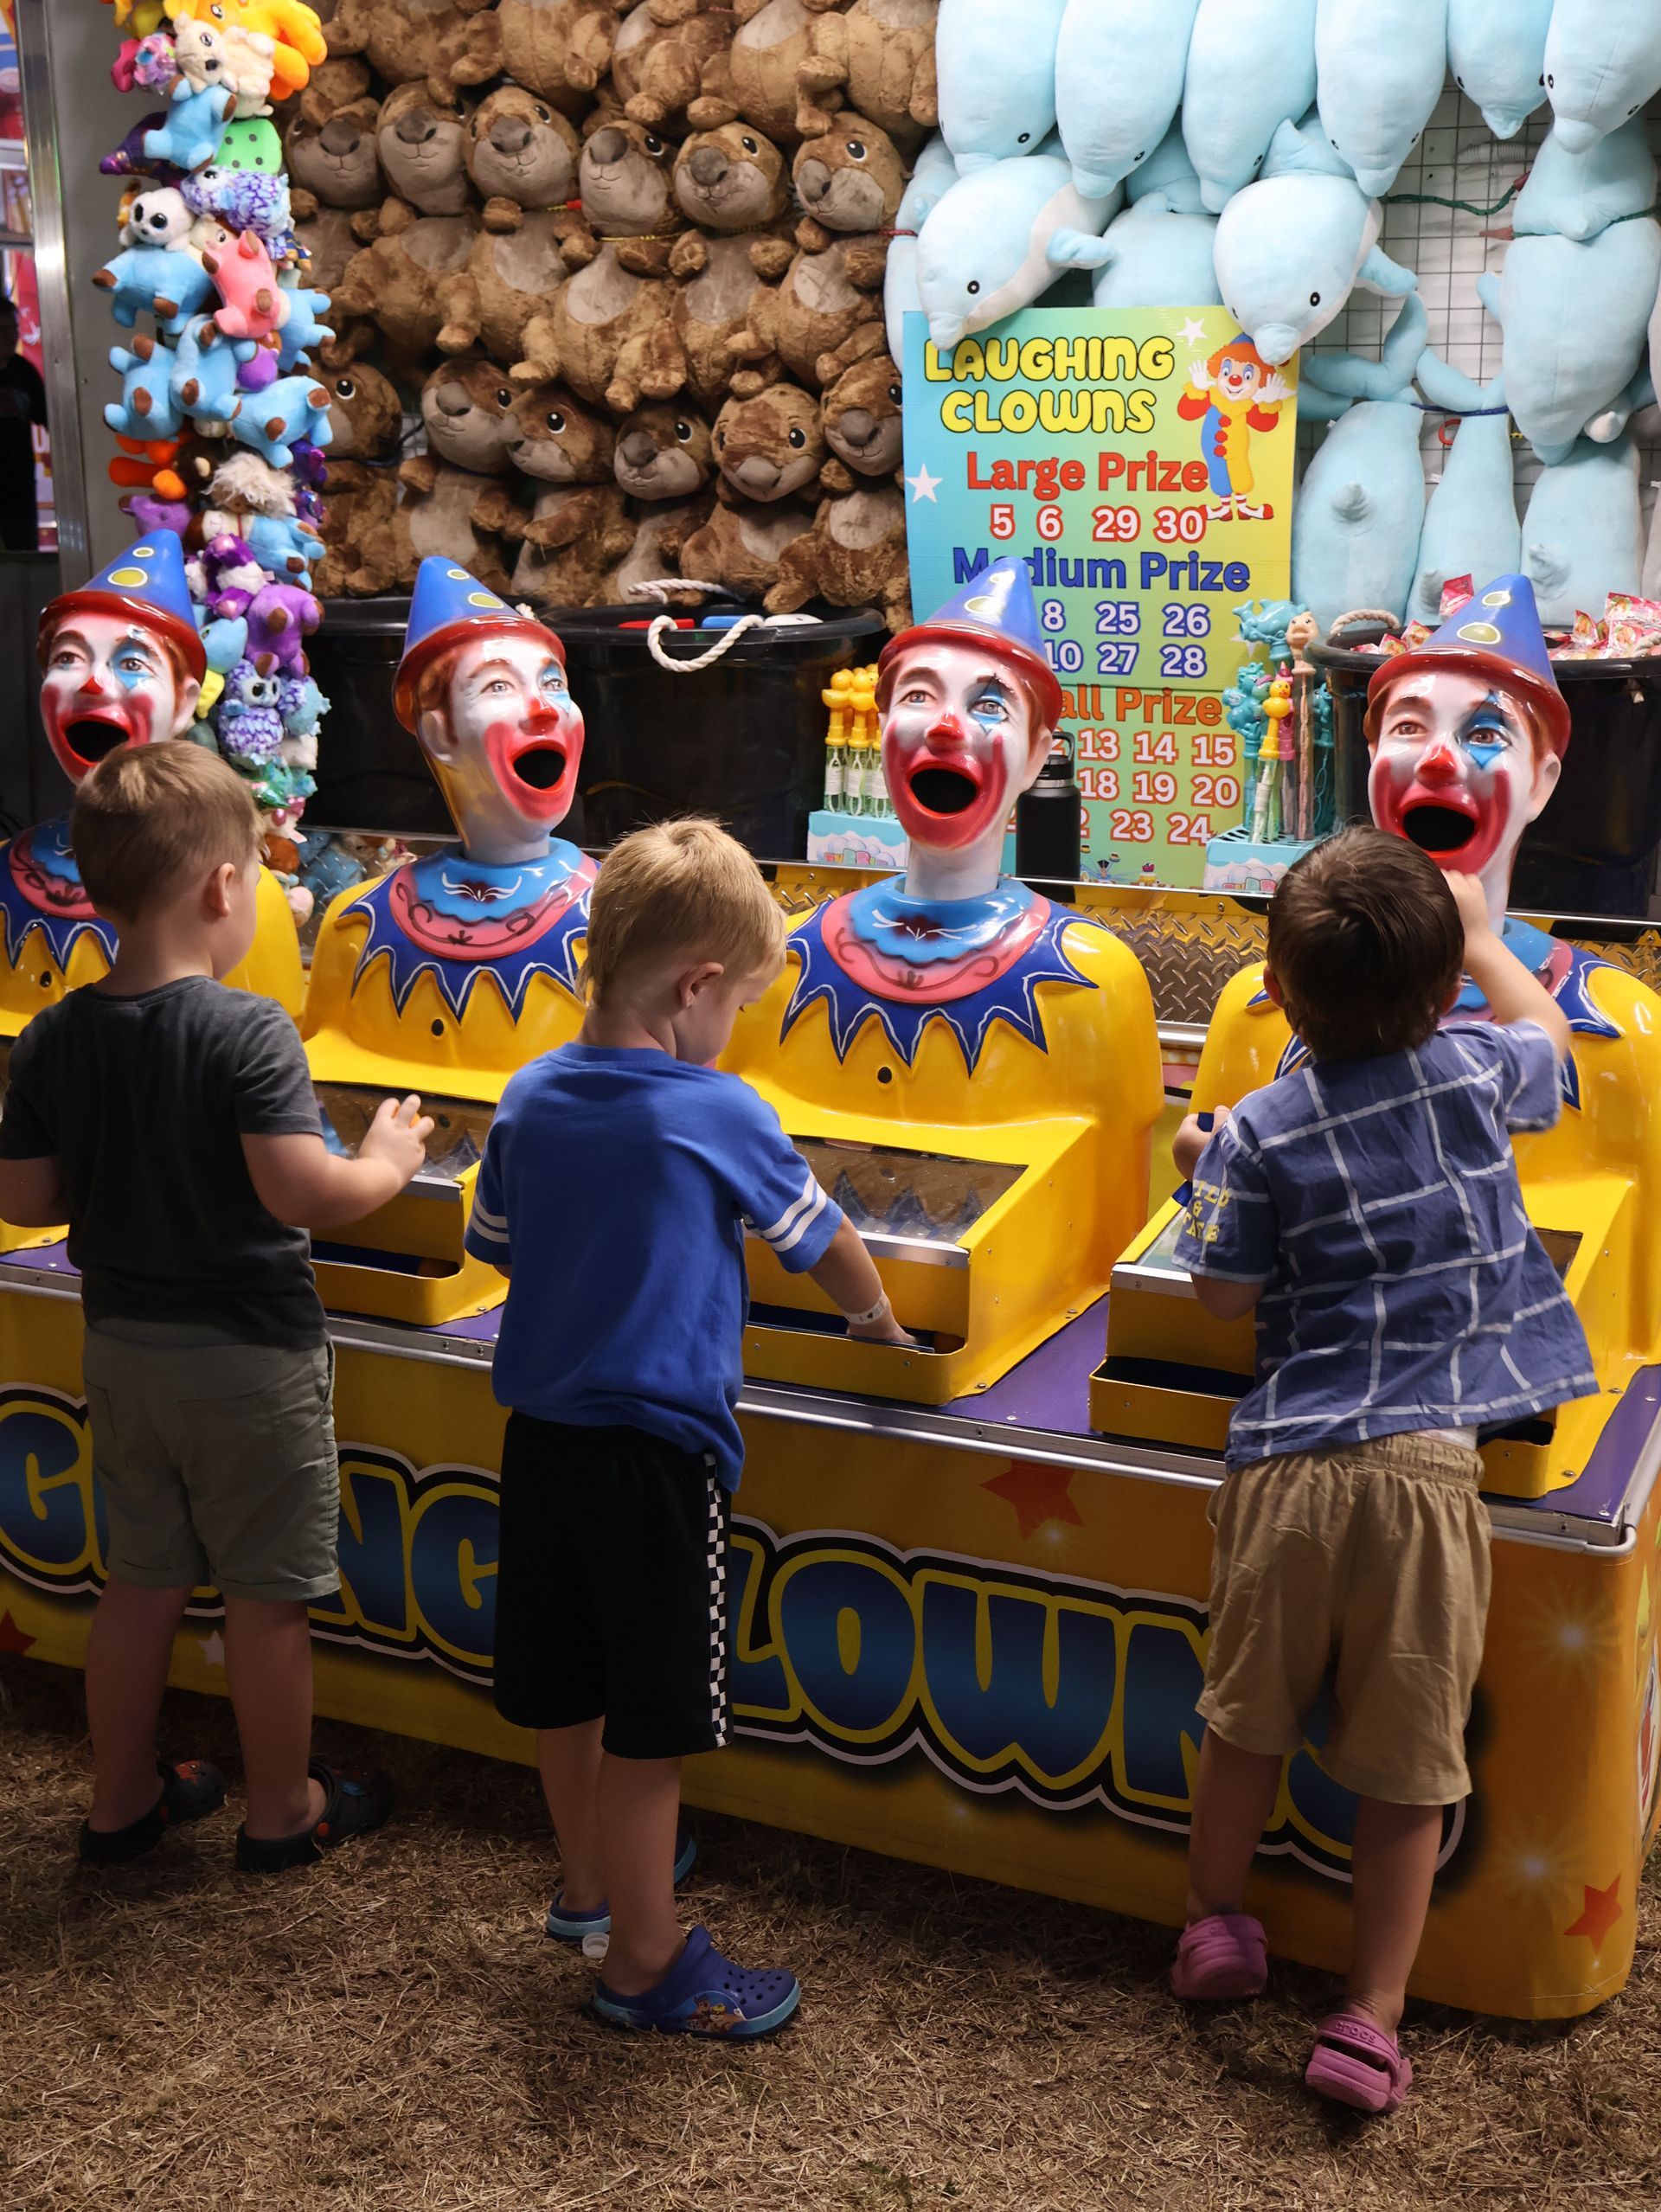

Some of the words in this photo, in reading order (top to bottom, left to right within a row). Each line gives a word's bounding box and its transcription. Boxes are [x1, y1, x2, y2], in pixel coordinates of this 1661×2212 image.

[924, 336, 1175, 381] LAUGHING
[940, 388, 1157, 433] CLOWNS
[966, 452, 1086, 501] Large
[1098, 450, 1209, 492] Prize
[990, 504, 1015, 541] 5
[1036, 504, 1063, 541] 6
[1092, 505, 1141, 543] 29
[1153, 505, 1207, 543] 30
[952, 547, 1127, 589] Mdium
[1139, 551, 1251, 592] Prize
[1041, 598, 1066, 633] 8
[1095, 599, 1141, 636] 25
[1162, 603, 1211, 638] 26
[1044, 639, 1083, 673] 10
[1097, 640, 1140, 675] 27
[1159, 644, 1208, 678] 28
[1060, 683, 1105, 721] all
[1115, 685, 1222, 726] Prize
[1077, 728, 1120, 762] 13
[1133, 731, 1179, 766] 14
[1191, 734, 1235, 767] 15
[1076, 767, 1119, 801] 18
[1132, 771, 1177, 803] 19
[1190, 774, 1241, 808] 20
[1110, 809, 1154, 843] 23
[1166, 812, 1212, 846] 24
[1193, 1180, 1229, 1209] ILD
